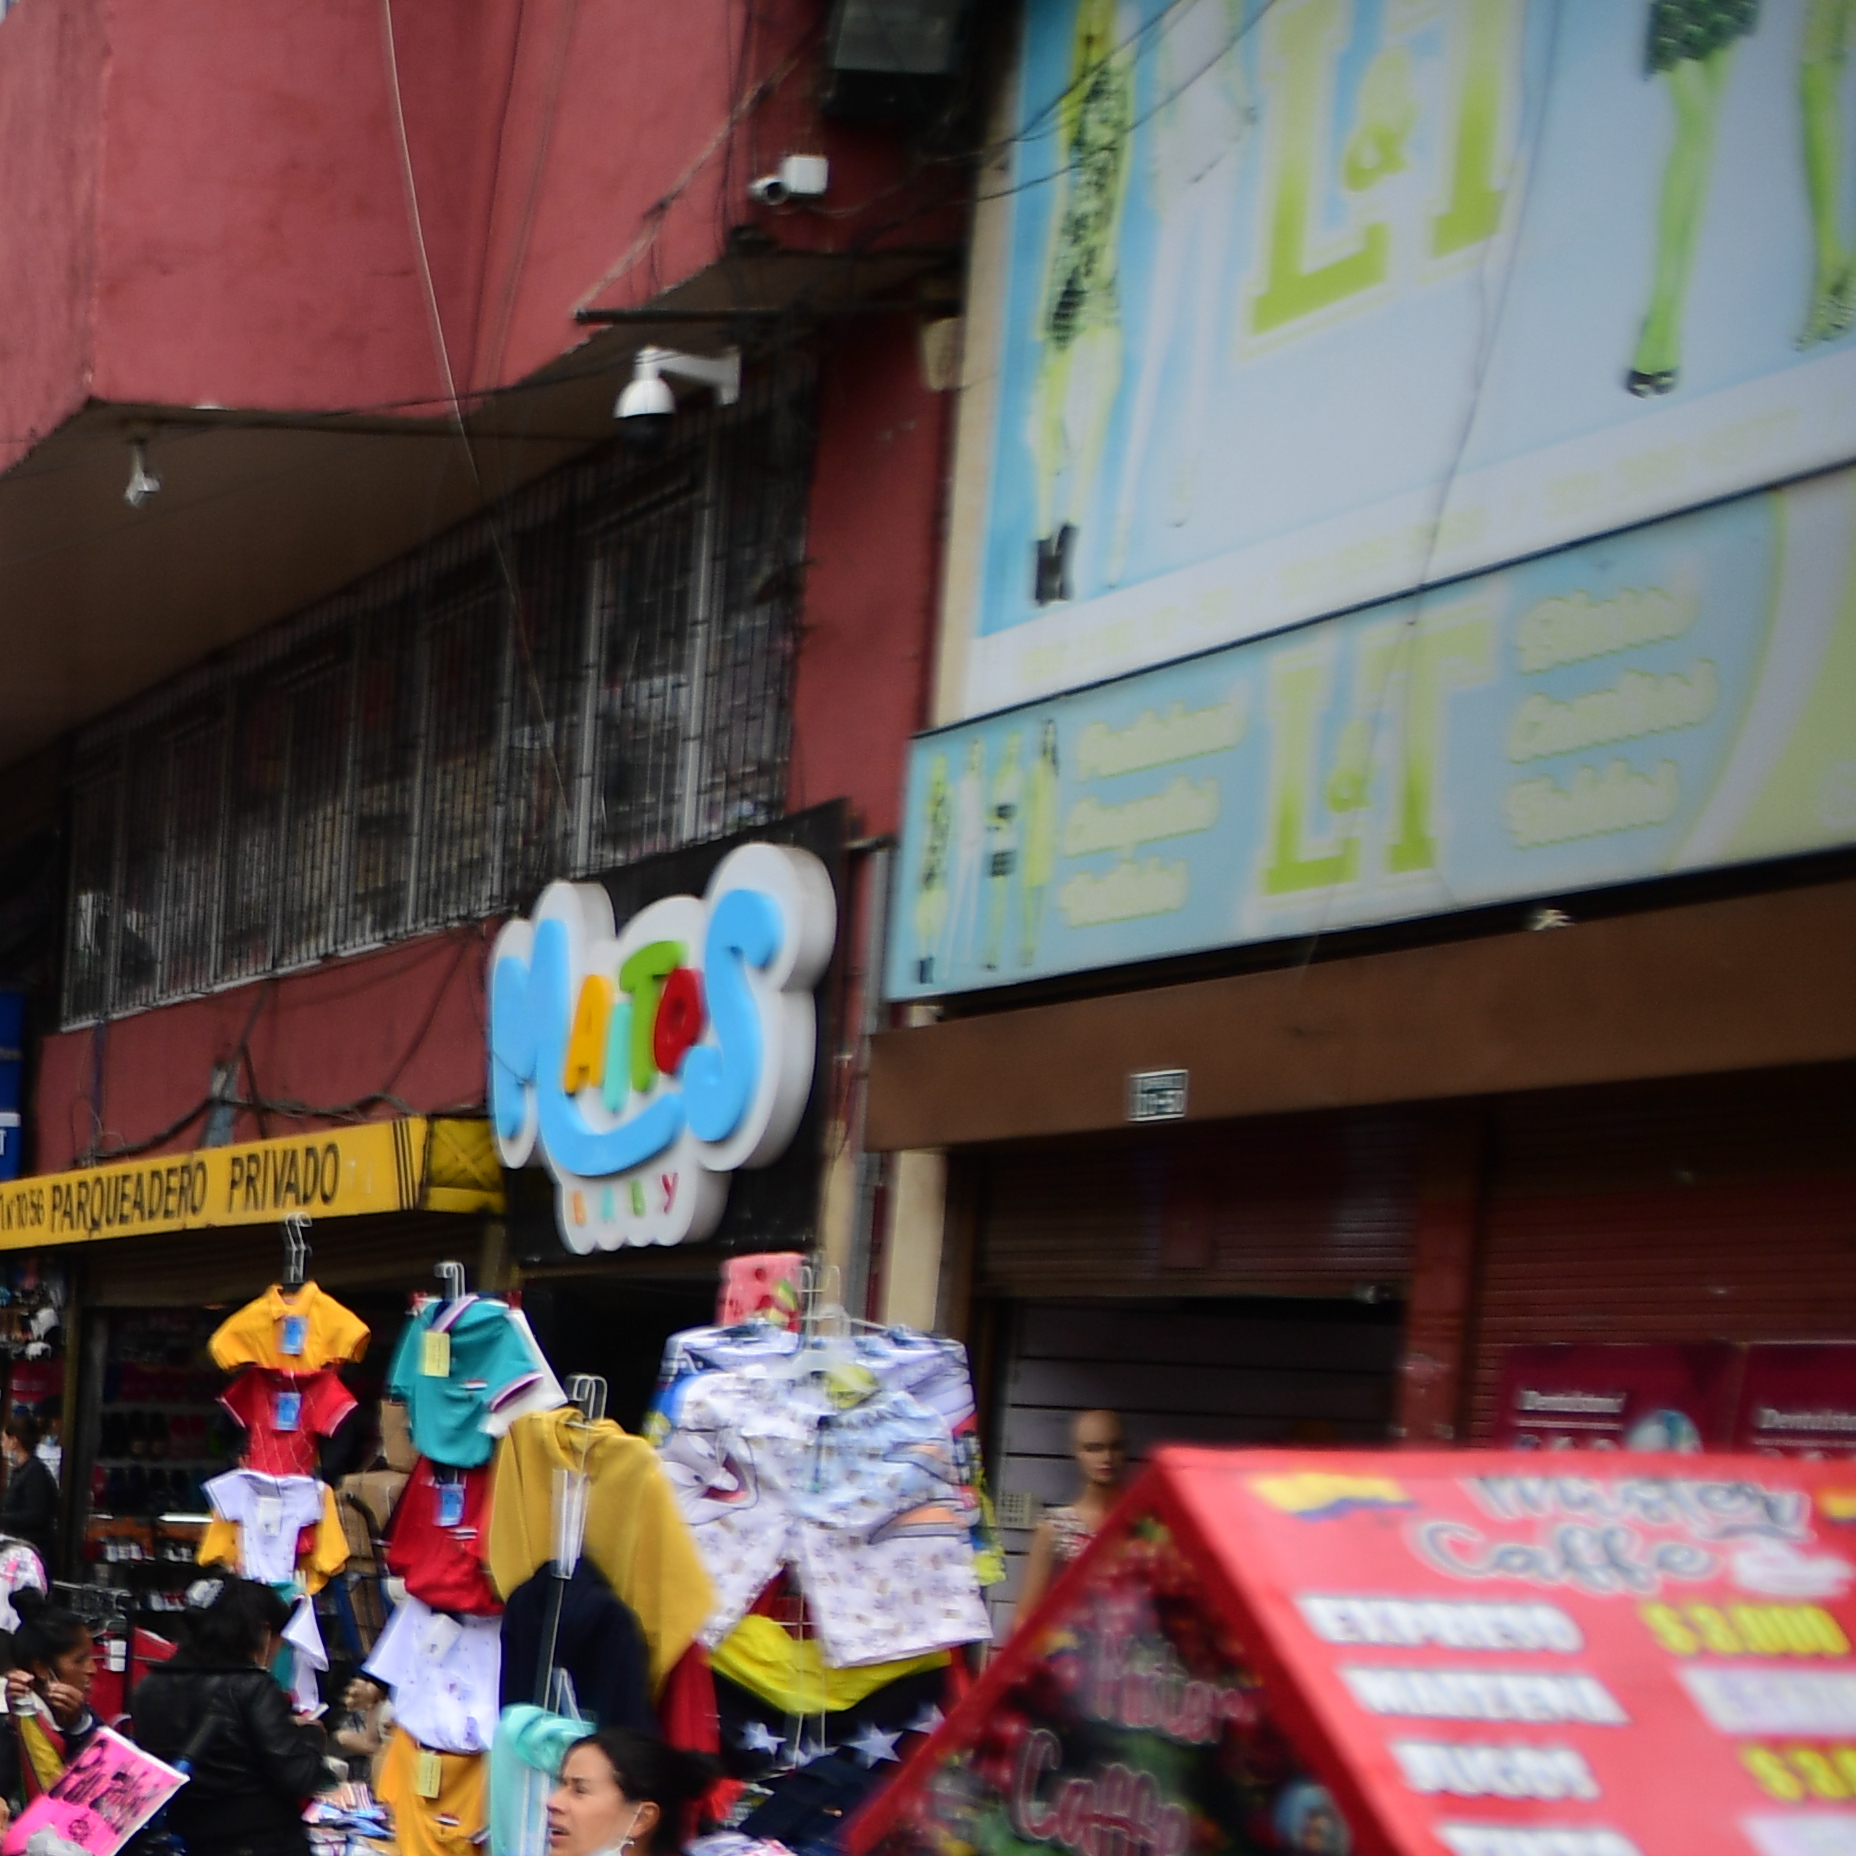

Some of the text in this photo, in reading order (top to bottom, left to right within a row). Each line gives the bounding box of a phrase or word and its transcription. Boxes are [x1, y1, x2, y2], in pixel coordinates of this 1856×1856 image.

[50, 1160, 208, 1237] PARQUEADERO
[228, 1142, 341, 1214] PRIVADO
[1410, 1520, 1720, 1593] Caffe
